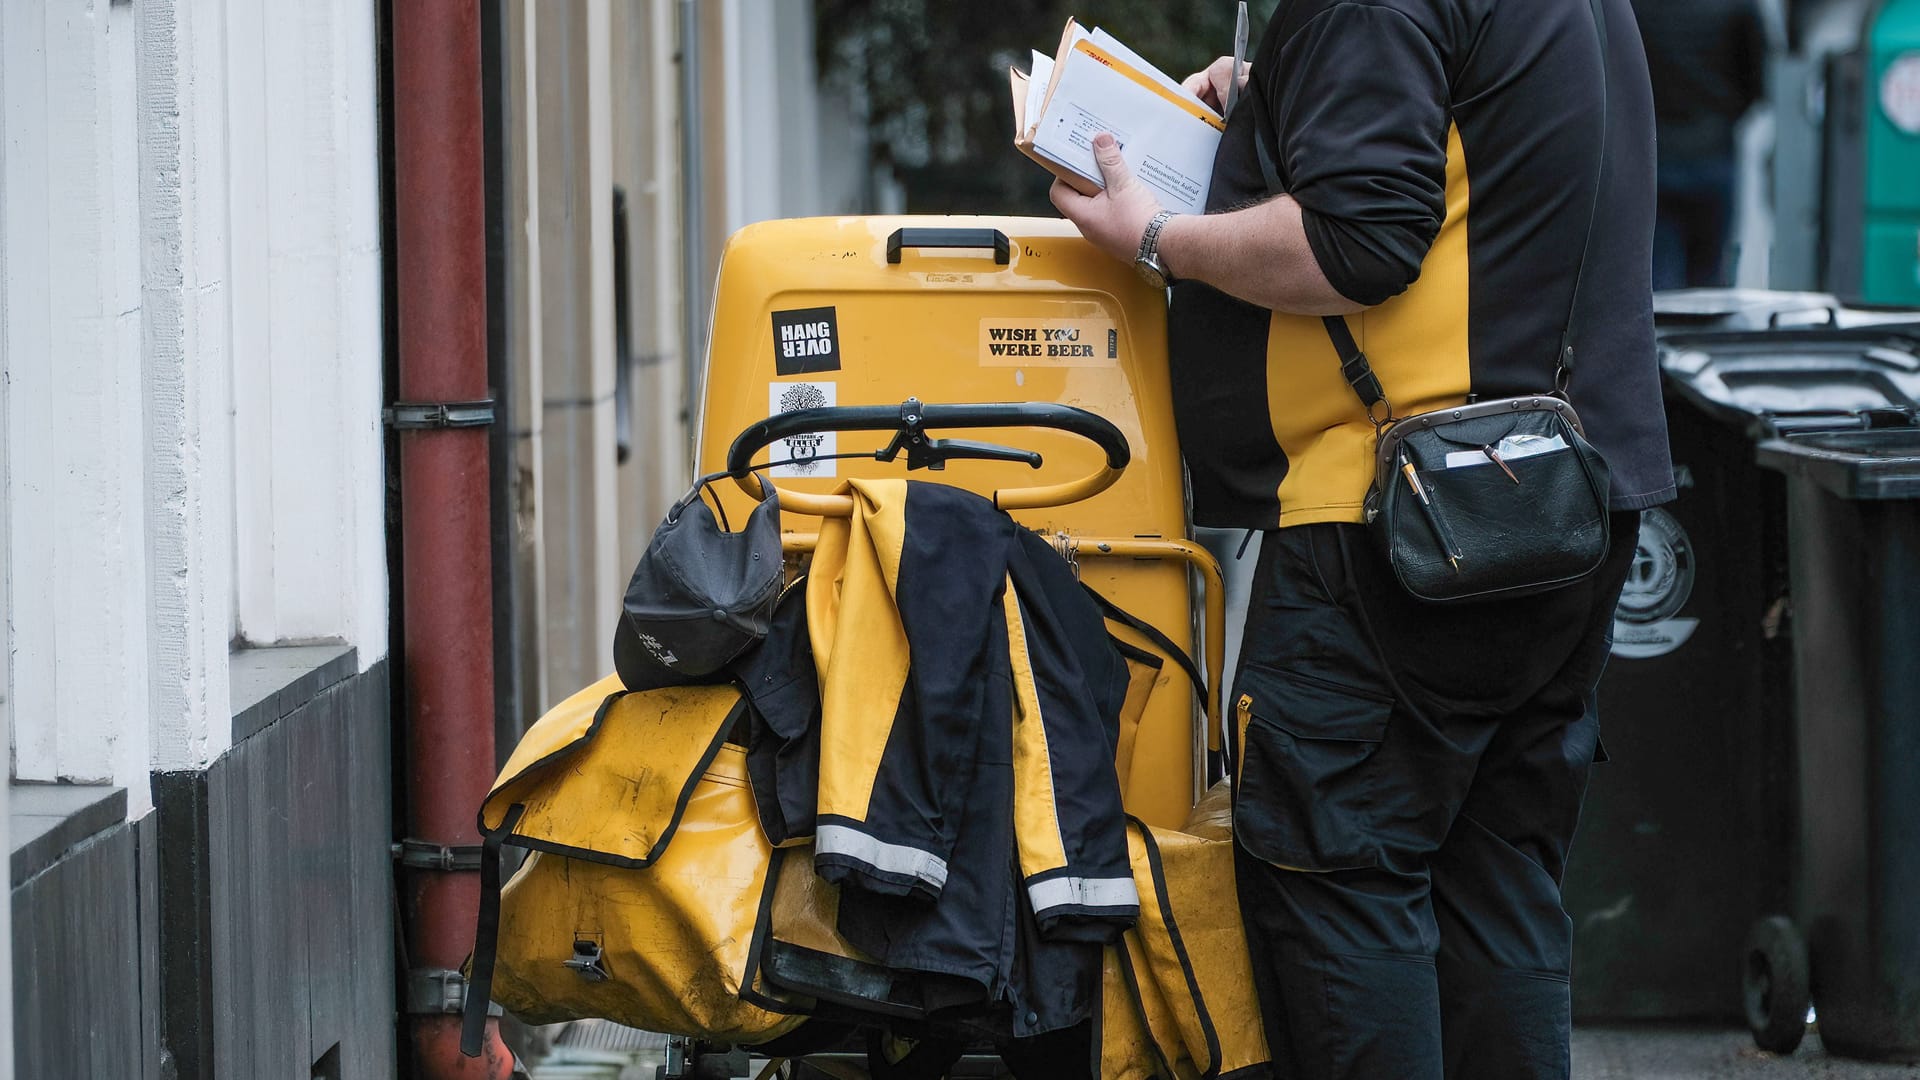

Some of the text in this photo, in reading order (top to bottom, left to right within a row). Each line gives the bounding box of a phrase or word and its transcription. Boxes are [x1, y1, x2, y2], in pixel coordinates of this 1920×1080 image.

[781, 321, 830, 341] HANG
[989, 328, 1037, 341] WISH
[782, 338, 832, 358] OVER
[989, 344, 1094, 357] WERE BEER
